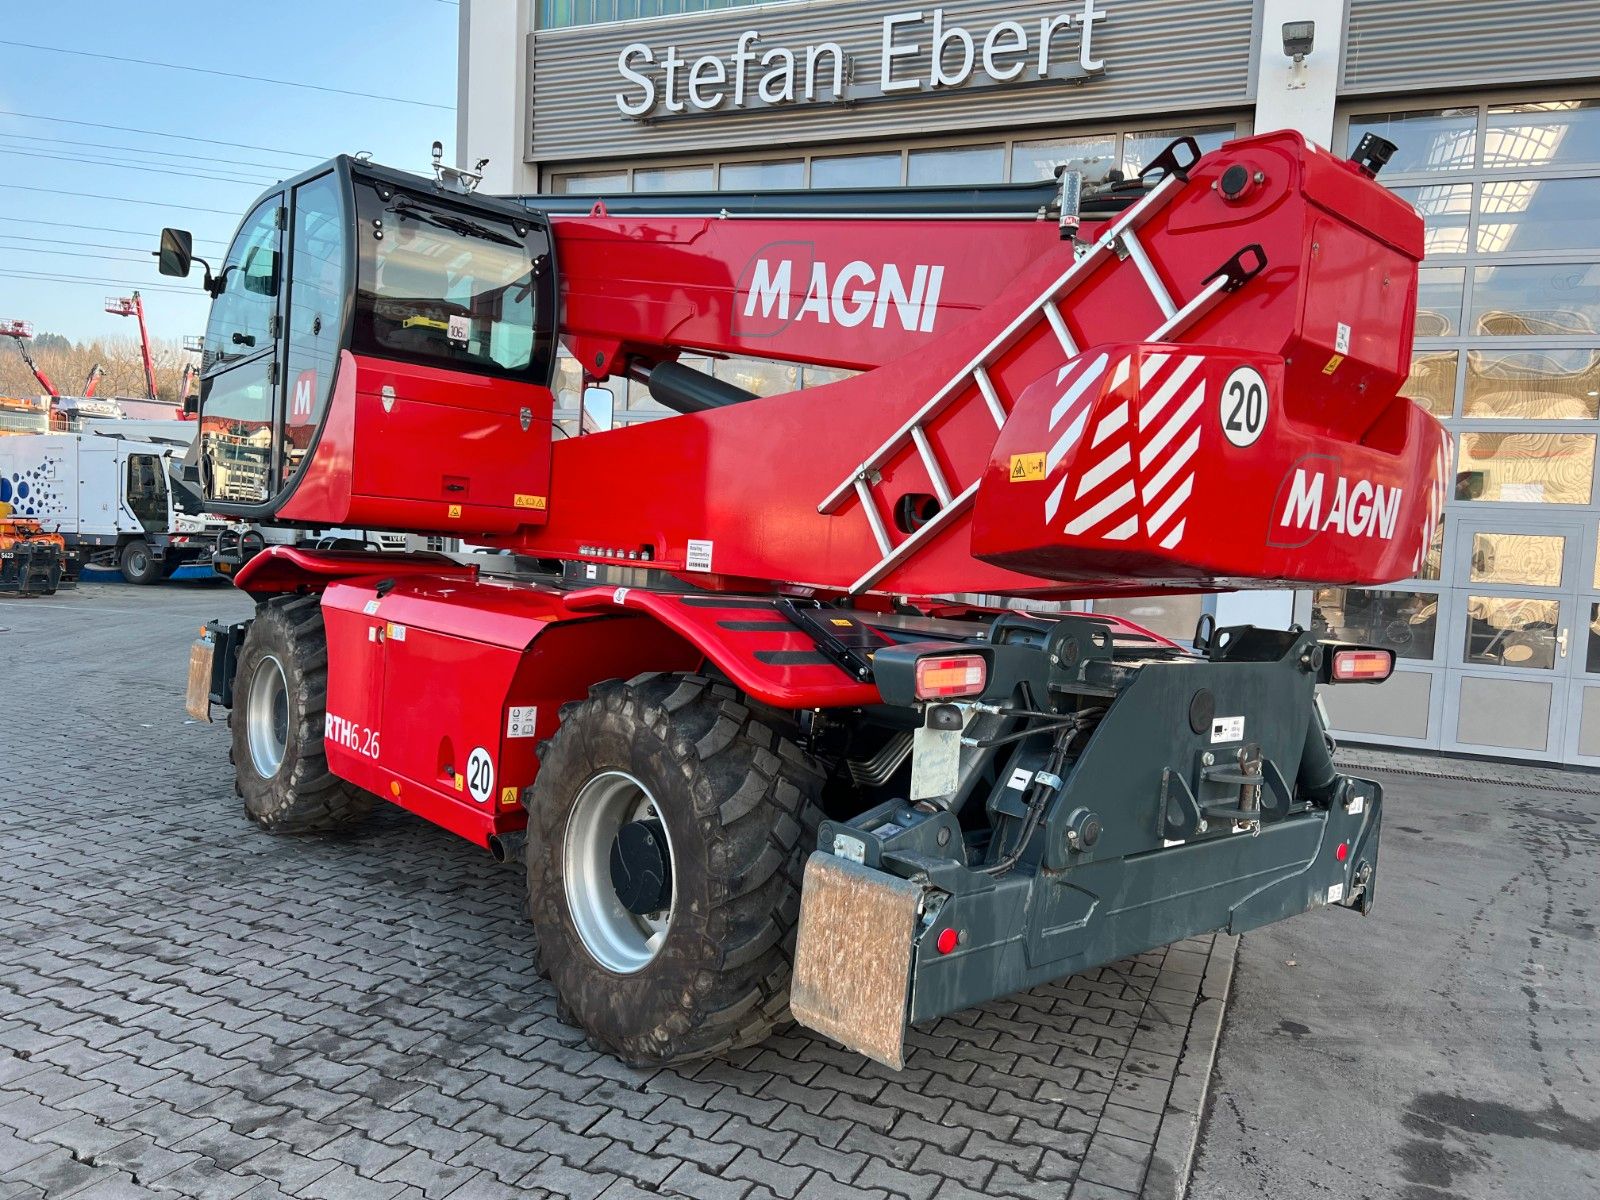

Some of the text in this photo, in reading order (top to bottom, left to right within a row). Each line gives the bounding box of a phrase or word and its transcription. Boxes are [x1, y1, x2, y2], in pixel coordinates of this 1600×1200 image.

[614, 0, 1107, 116] Stefan Ebert
[743, 258, 946, 334] MAGNI
[293, 379, 310, 412] M
[1225, 380, 1262, 433] 20
[1280, 468, 1404, 540] MAGNI
[323, 711, 381, 760] RTH6.26
[470, 755, 491, 795] 20
